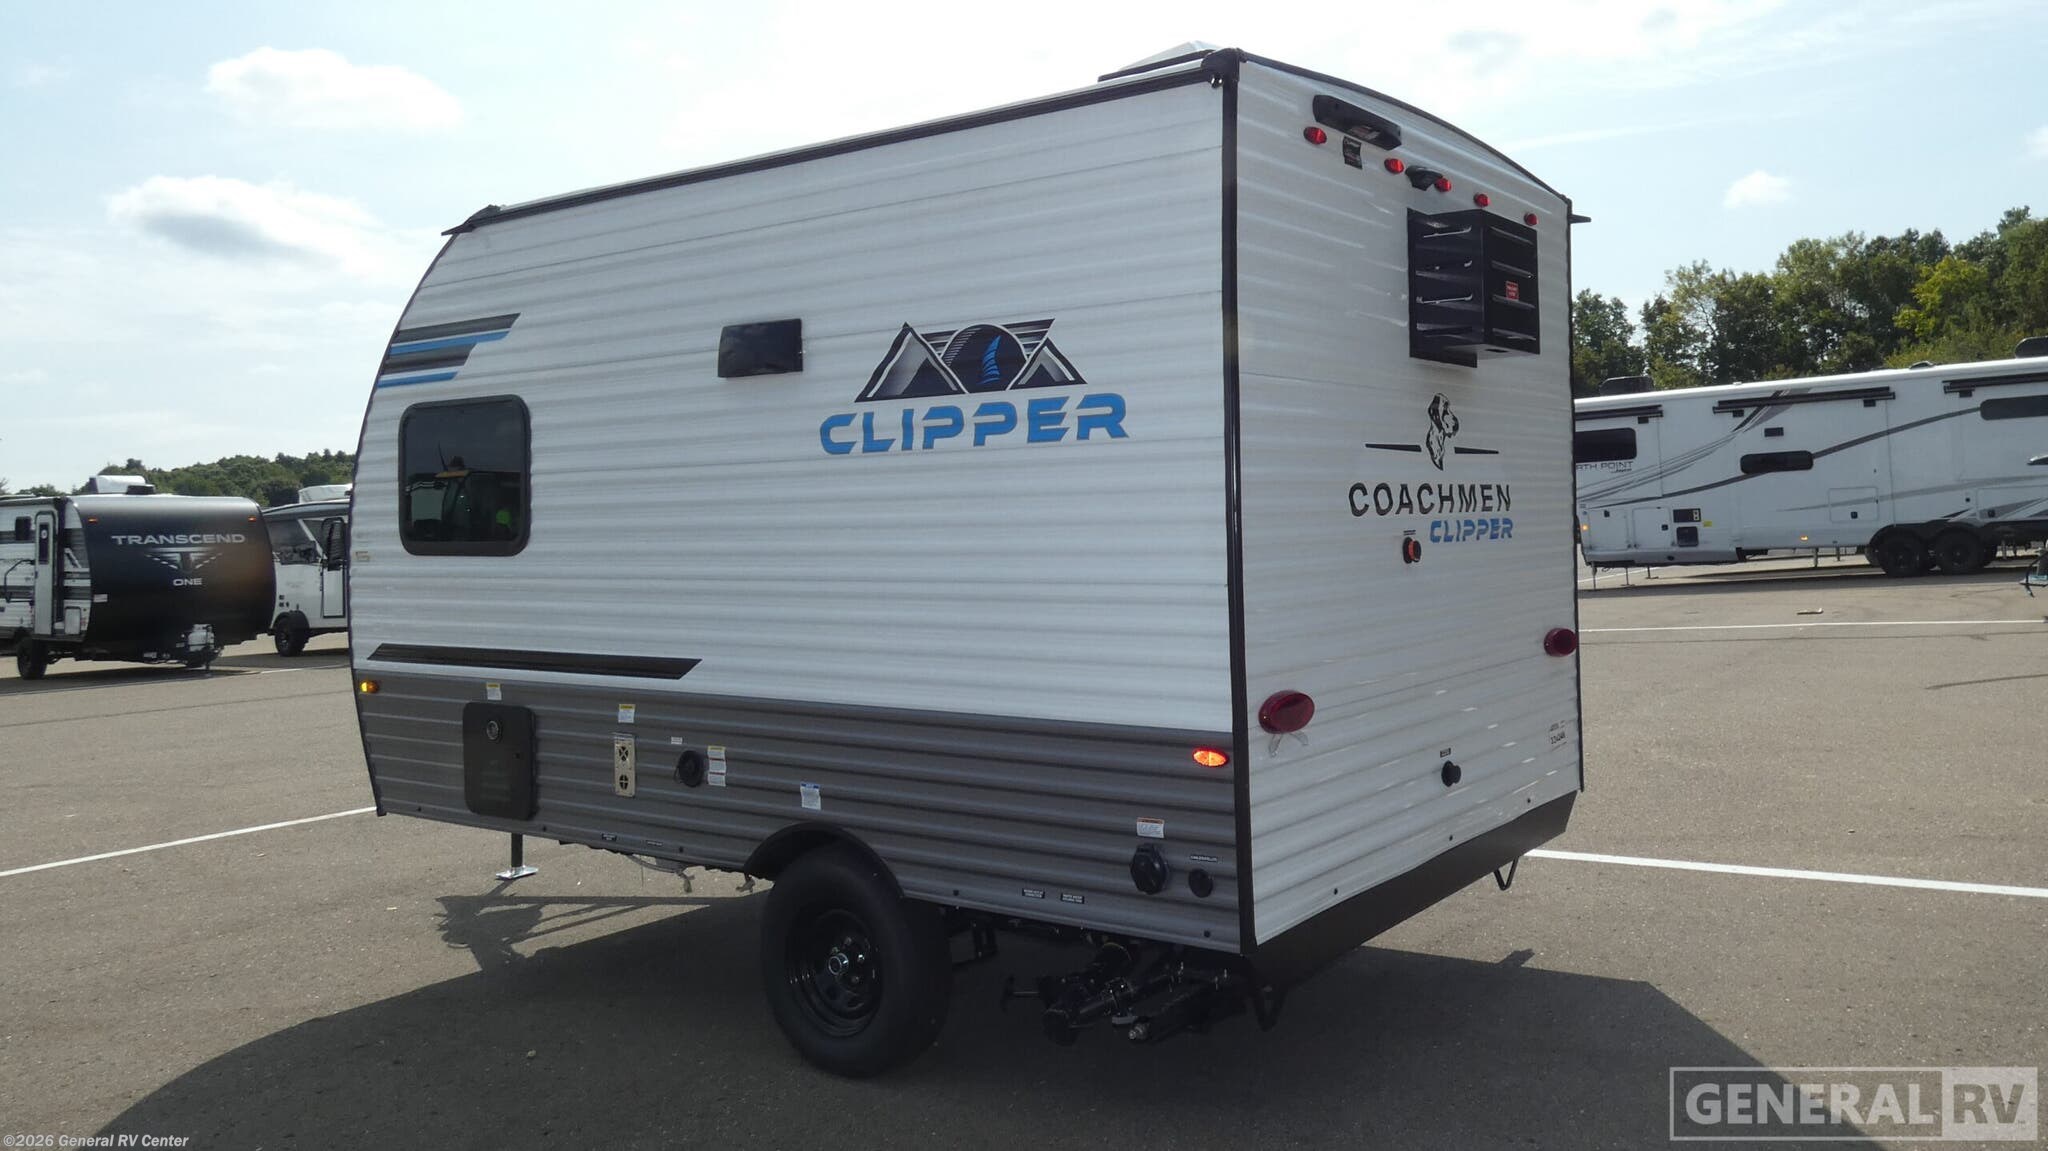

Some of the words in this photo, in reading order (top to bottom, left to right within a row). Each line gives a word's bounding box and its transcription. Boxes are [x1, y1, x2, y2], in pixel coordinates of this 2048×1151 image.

[819, 392, 1130, 455] CLIPPER
[1600, 461, 1634, 470] POINT
[1348, 482, 1512, 517] COACHMEN
[111, 533, 247, 545] TRANSCEND
[1429, 517, 1514, 543] CLIPPER
[173, 577, 203, 587] ONE
